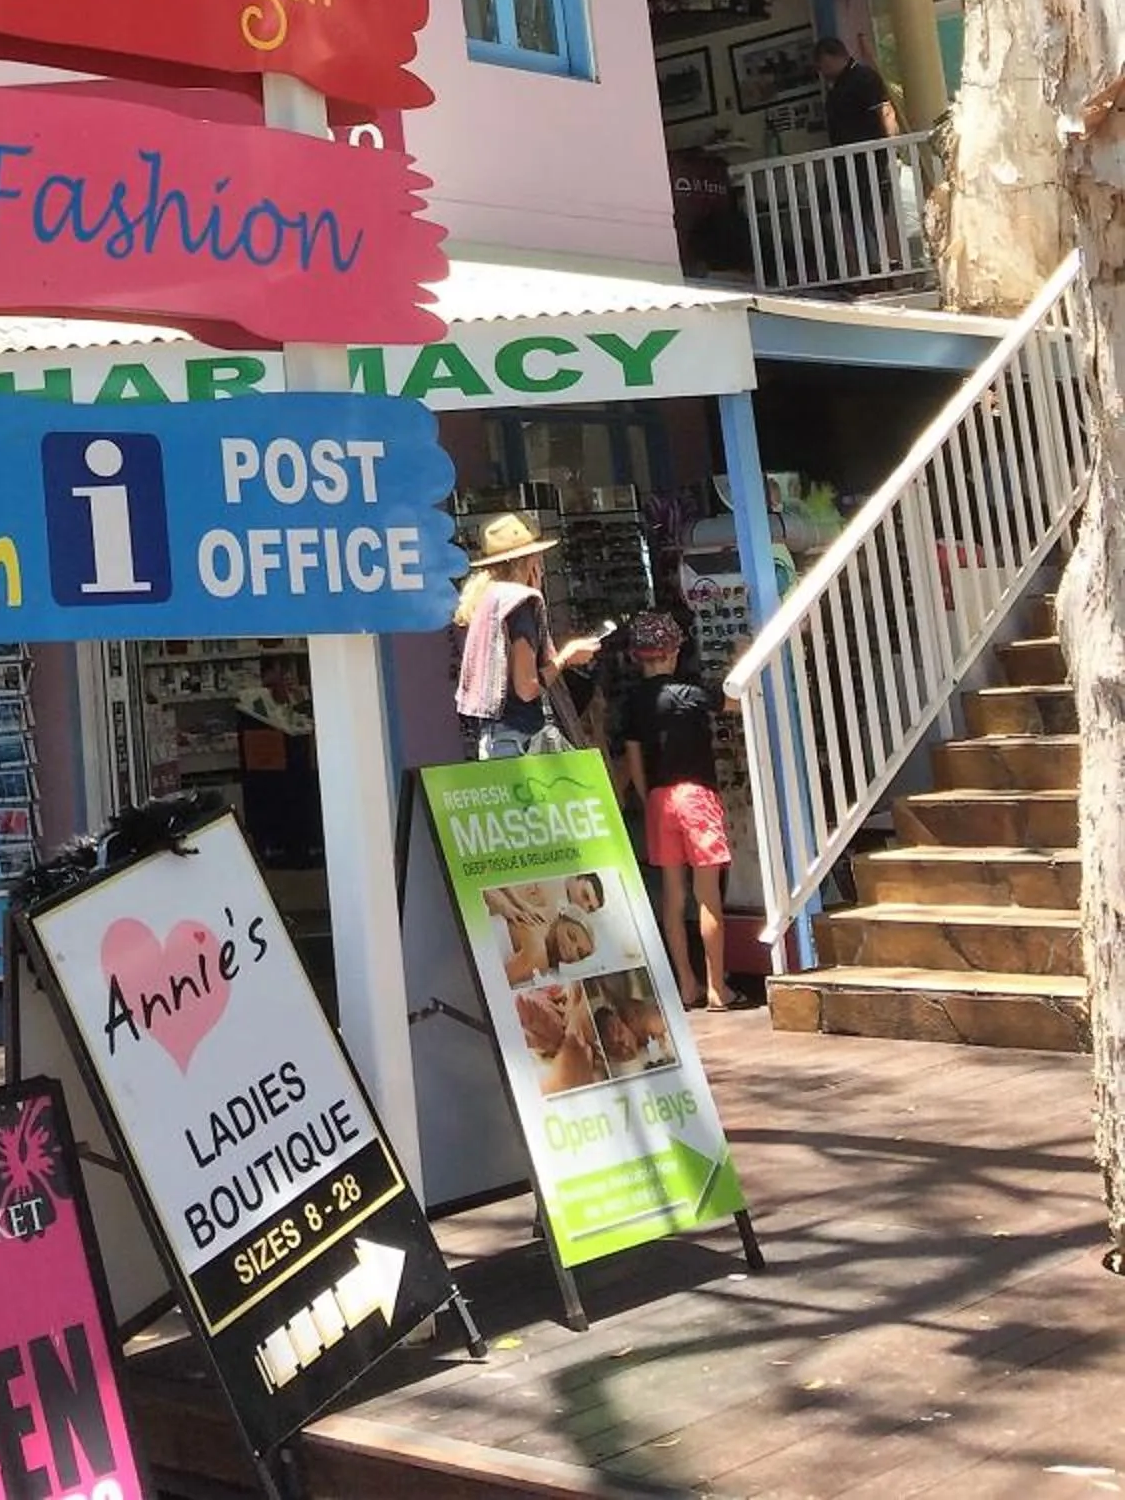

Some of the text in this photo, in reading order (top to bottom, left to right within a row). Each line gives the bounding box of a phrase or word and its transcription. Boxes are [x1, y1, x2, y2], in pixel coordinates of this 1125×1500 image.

[221, 437, 386, 505] POST
[197, 527, 425, 599] OFFICE
[442, 784, 510, 811] REFRESH
[448, 797, 611, 858] MASSAGE
[104, 906, 268, 1056] Annie's
[184, 1060, 307, 1169] LADIES
[543, 1087, 698, 1154] Open 7 days
[183, 1098, 360, 1250] BOUTIQUE
[233, 1217, 303, 1285] SIZES
